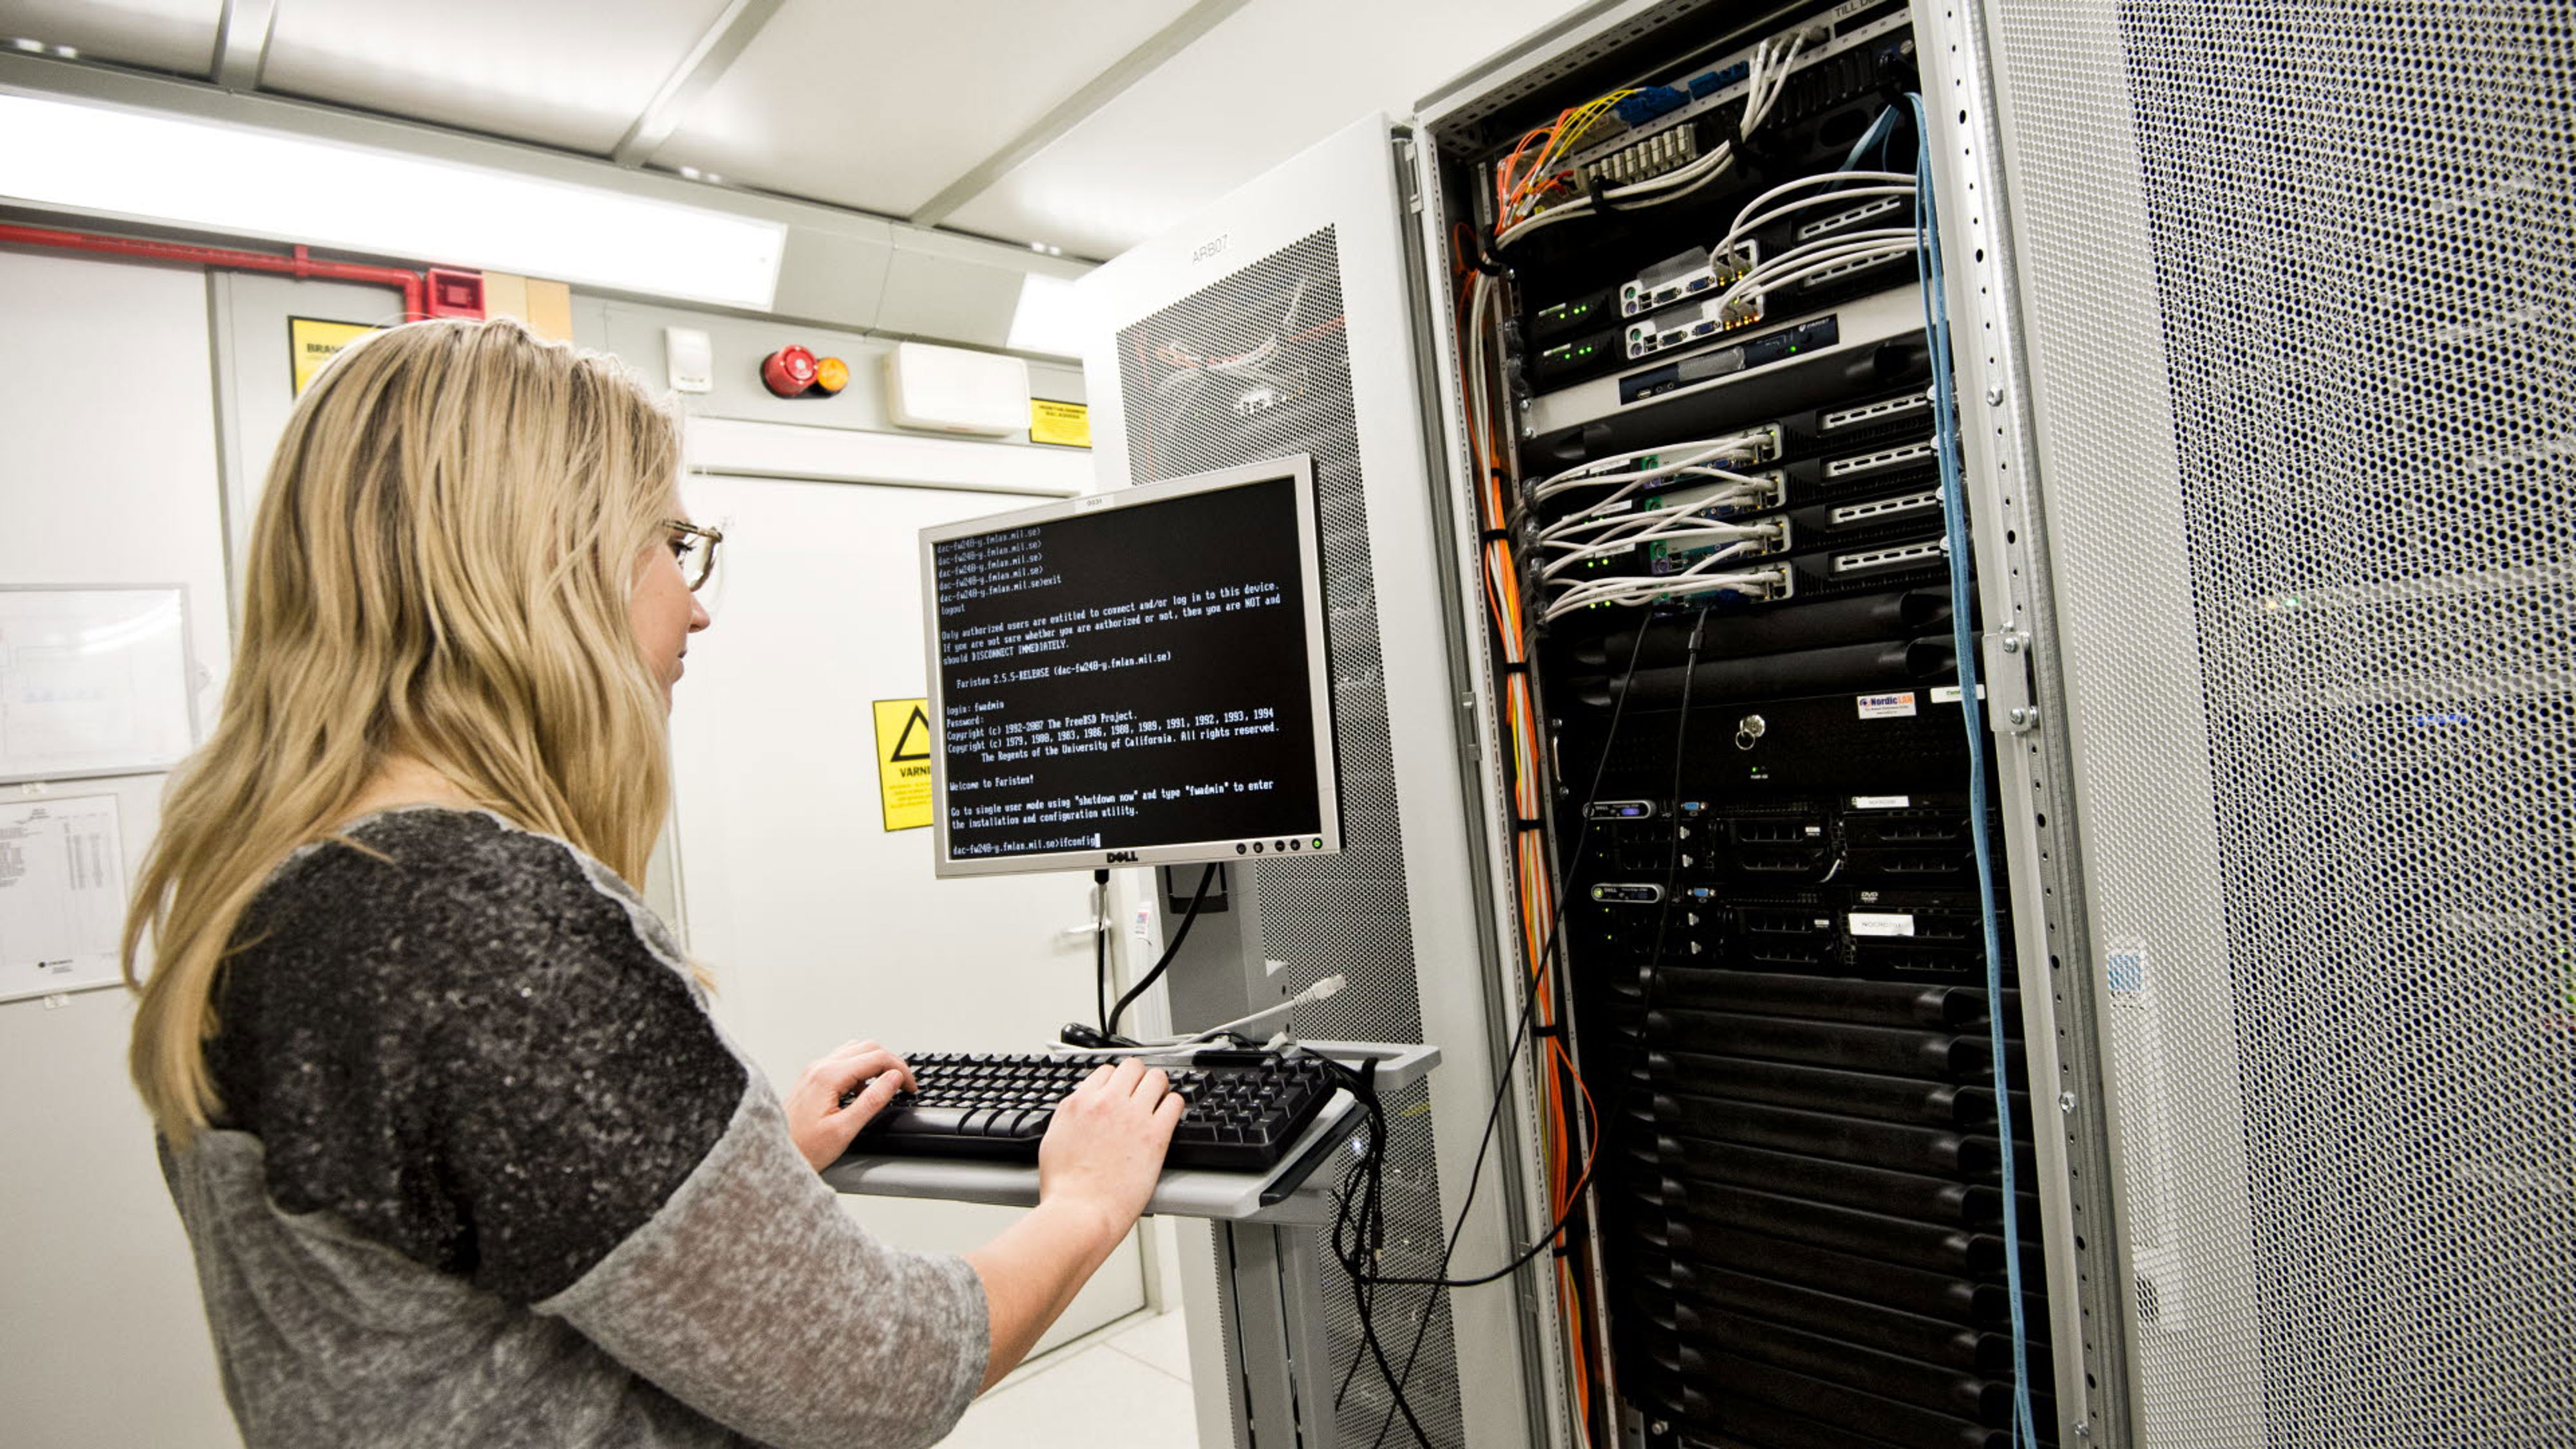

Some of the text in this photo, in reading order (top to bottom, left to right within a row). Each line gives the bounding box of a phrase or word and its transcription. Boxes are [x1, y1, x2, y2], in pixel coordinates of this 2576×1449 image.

[941, 602, 965, 616] logout
[942, 582, 1278, 640] Only authorized users are entitled to connect and/or log in to this device.
[943, 642, 952, 652] If
[955, 642, 968, 652] you
[988, 635, 1001, 645] not
[1004, 634, 1021, 643] sure
[1025, 629, 1056, 640] whether
[1059, 627, 1073, 638] you
[1077, 624, 1091, 632] are
[1095, 614, 1141, 630] authorized
[1159, 610, 1177, 621] not,
[1182, 607, 1202, 618] then
[1206, 605, 1221, 616] you
[1225, 603, 1240, 611] are
[1244, 597, 1260, 609] NOT
[1264, 594, 1280, 605] and
[943, 639, 1069, 664] should DISCONNECT IMMEDIATELY.
[994, 667, 1050, 683] 2.5.5-RELEASE
[946, 699, 1004, 716] login: fwadmin
[947, 715, 984, 727] Password:
[947, 727, 985, 741] Copyright
[989, 725, 1001, 735] (c)
[1048, 719, 1061, 728] The
[1065, 714, 1097, 726] FreeBSD
[1101, 710, 1137, 724] Project.
[948, 740, 985, 754] Copyright
[989, 738, 1002, 748] (c)
[981, 723, 1279, 762] The Regents of the University of California. All rights reserved.
[900, 766, 931, 778] VARNI
[951, 781, 980, 790] Welcome
[983, 778, 992, 787] to
[952, 807, 960, 816] Go
[964, 806, 972, 815] to
[976, 803, 1002, 815] single
[1027, 800, 1045, 810] mode
[1048, 798, 1071, 809] using
[1142, 790, 1157, 800] and
[1160, 789, 1180, 800] type
[1233, 782, 1244, 792] to
[1248, 781, 1274, 791] enter
[952, 806, 1139, 828] the installation and configuration utility.
[1107, 851, 1138, 863] DELL
